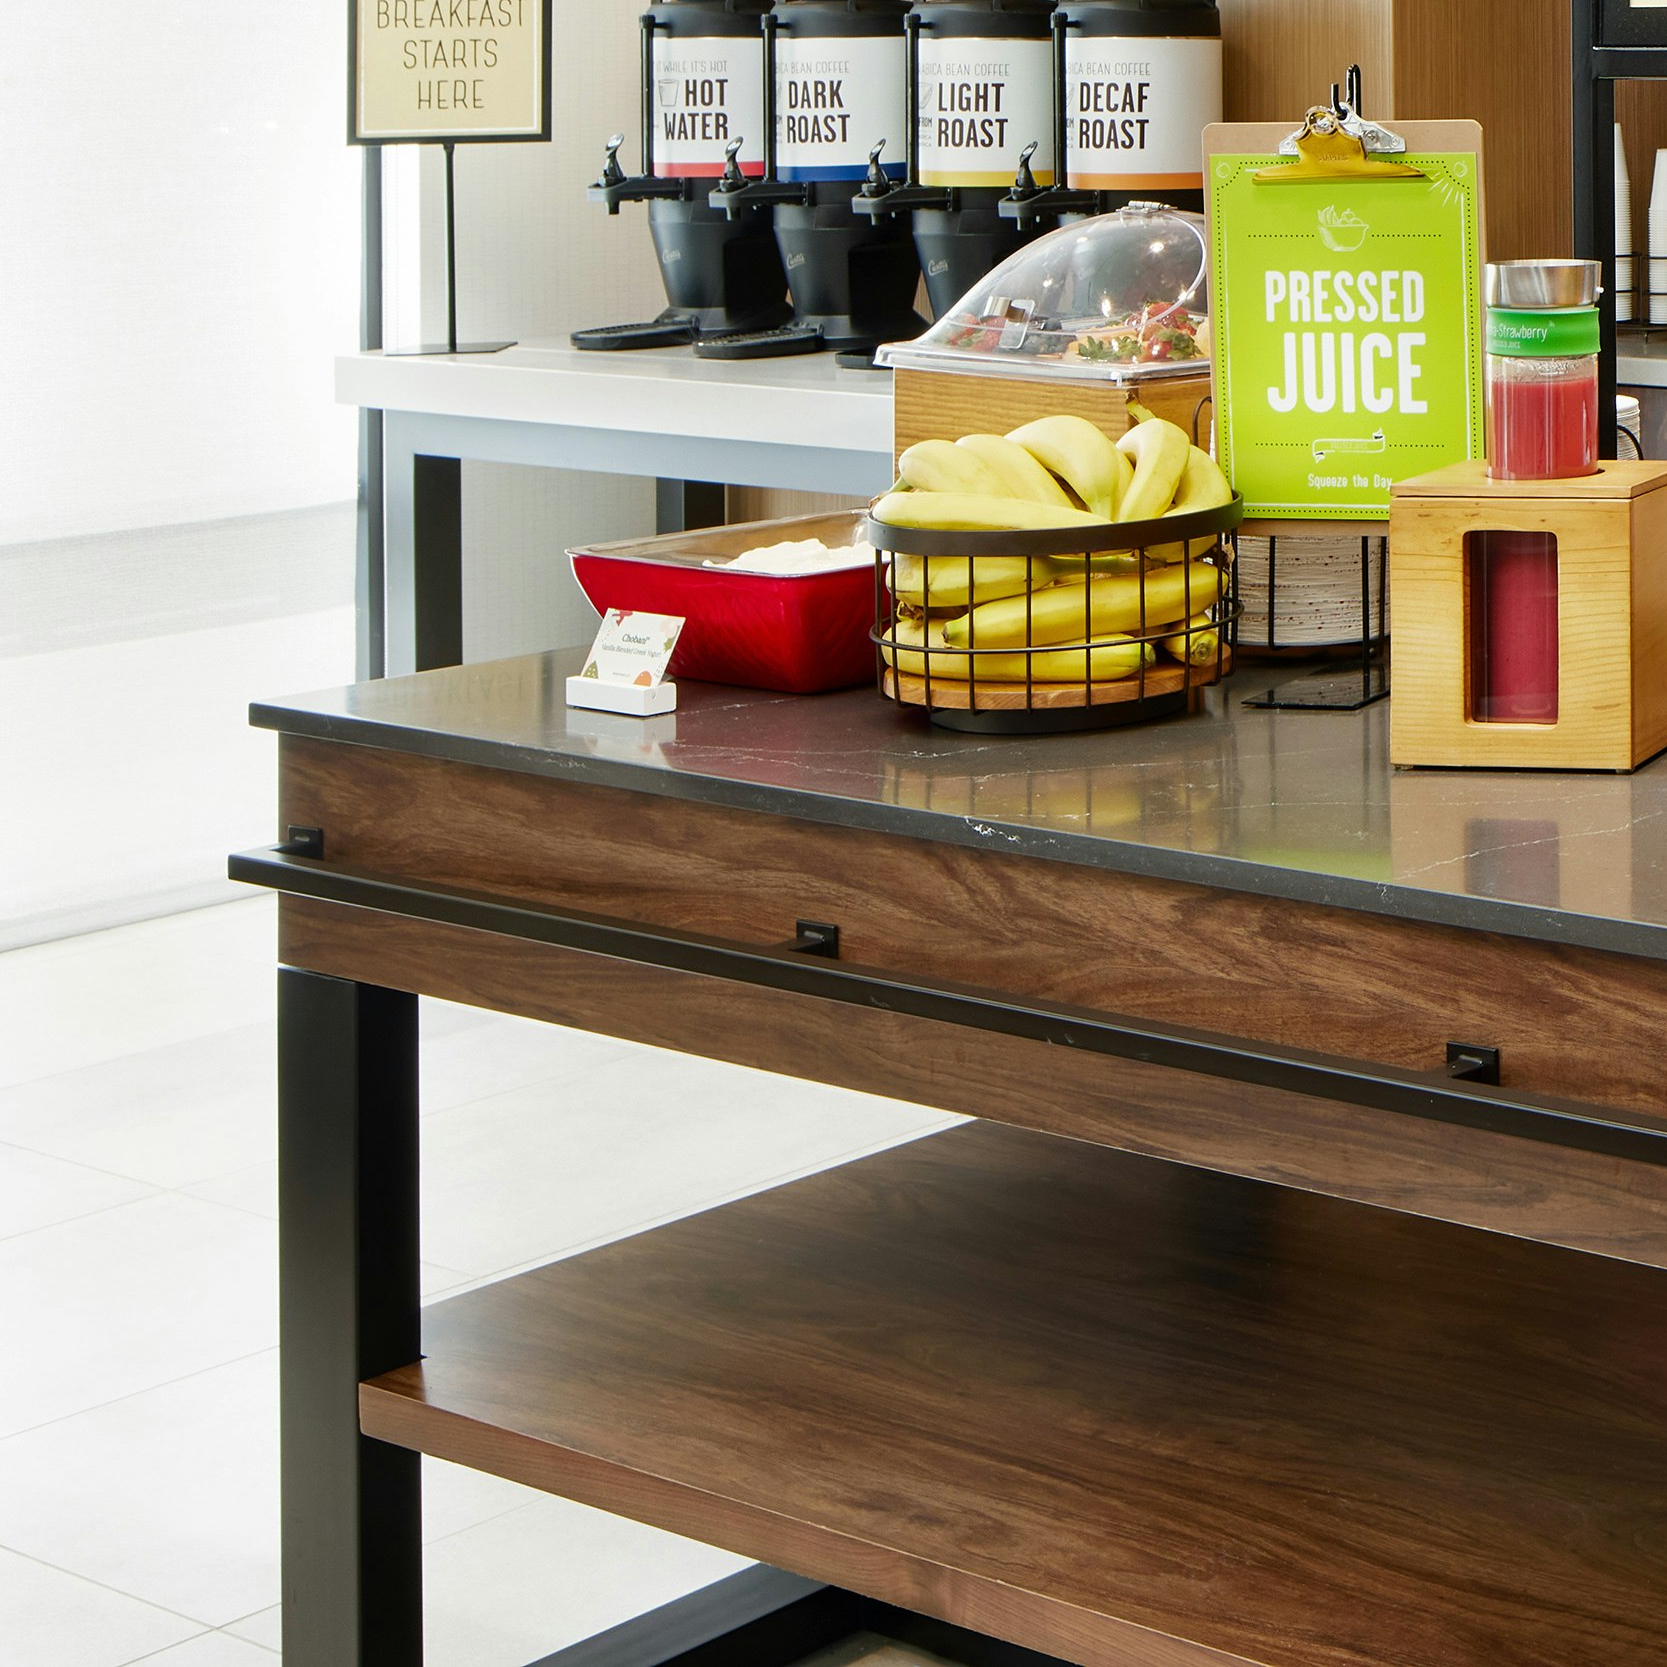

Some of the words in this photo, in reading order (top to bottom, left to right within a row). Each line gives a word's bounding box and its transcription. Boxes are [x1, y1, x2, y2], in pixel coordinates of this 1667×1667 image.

[403, 38, 498, 69] STARTS
[710, 60, 728, 72] HOT
[790, 61, 812, 74] BEAN
[816, 60, 851, 74] COFFEE
[946, 63, 970, 76] BEAN
[974, 63, 1010, 77] COFFEE
[1086, 62, 1110, 75] BEAN
[1114, 62, 1151, 76] COFFEE
[418, 79, 485, 110] HERE
[685, 79, 728, 107] HOT
[788, 80, 844, 109] DARK
[938, 82, 1005, 112] LIGHT
[1079, 82, 1150, 112] DECAF
[664, 113, 728, 141] WATER
[787, 114, 850, 144] ROAST
[938, 118, 1008, 148] ROAST
[1079, 119, 1150, 149] ROAST
[1265, 270, 1425, 323] PRESSED
[1267, 332, 1428, 414] JUICE
[1307, 473, 1348, 489] Squeeze
[1352, 474, 1368, 487] the
[1373, 473, 1392, 491] Day
